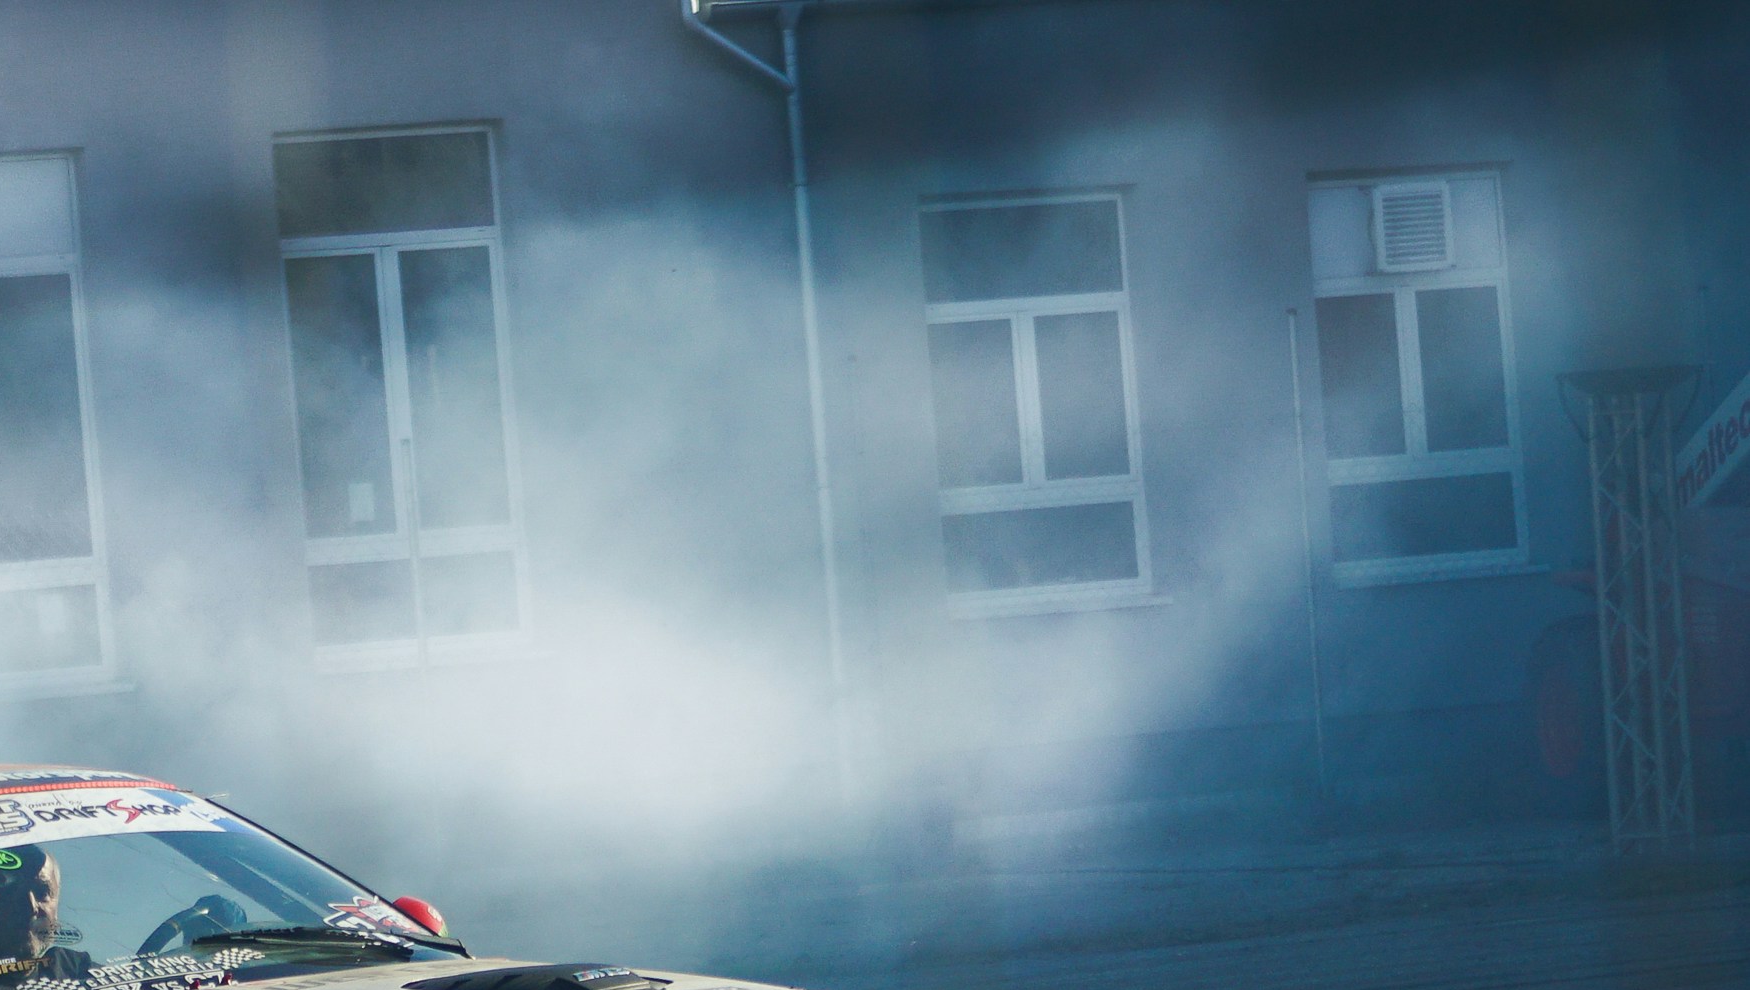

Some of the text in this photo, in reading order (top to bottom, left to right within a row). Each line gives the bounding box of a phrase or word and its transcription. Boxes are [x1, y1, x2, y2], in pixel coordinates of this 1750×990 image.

[86, 962, 215, 988] CHAMPIONSHIP
[87, 960, 145, 979] DRIFT
[148, 955, 198, 969] KING
